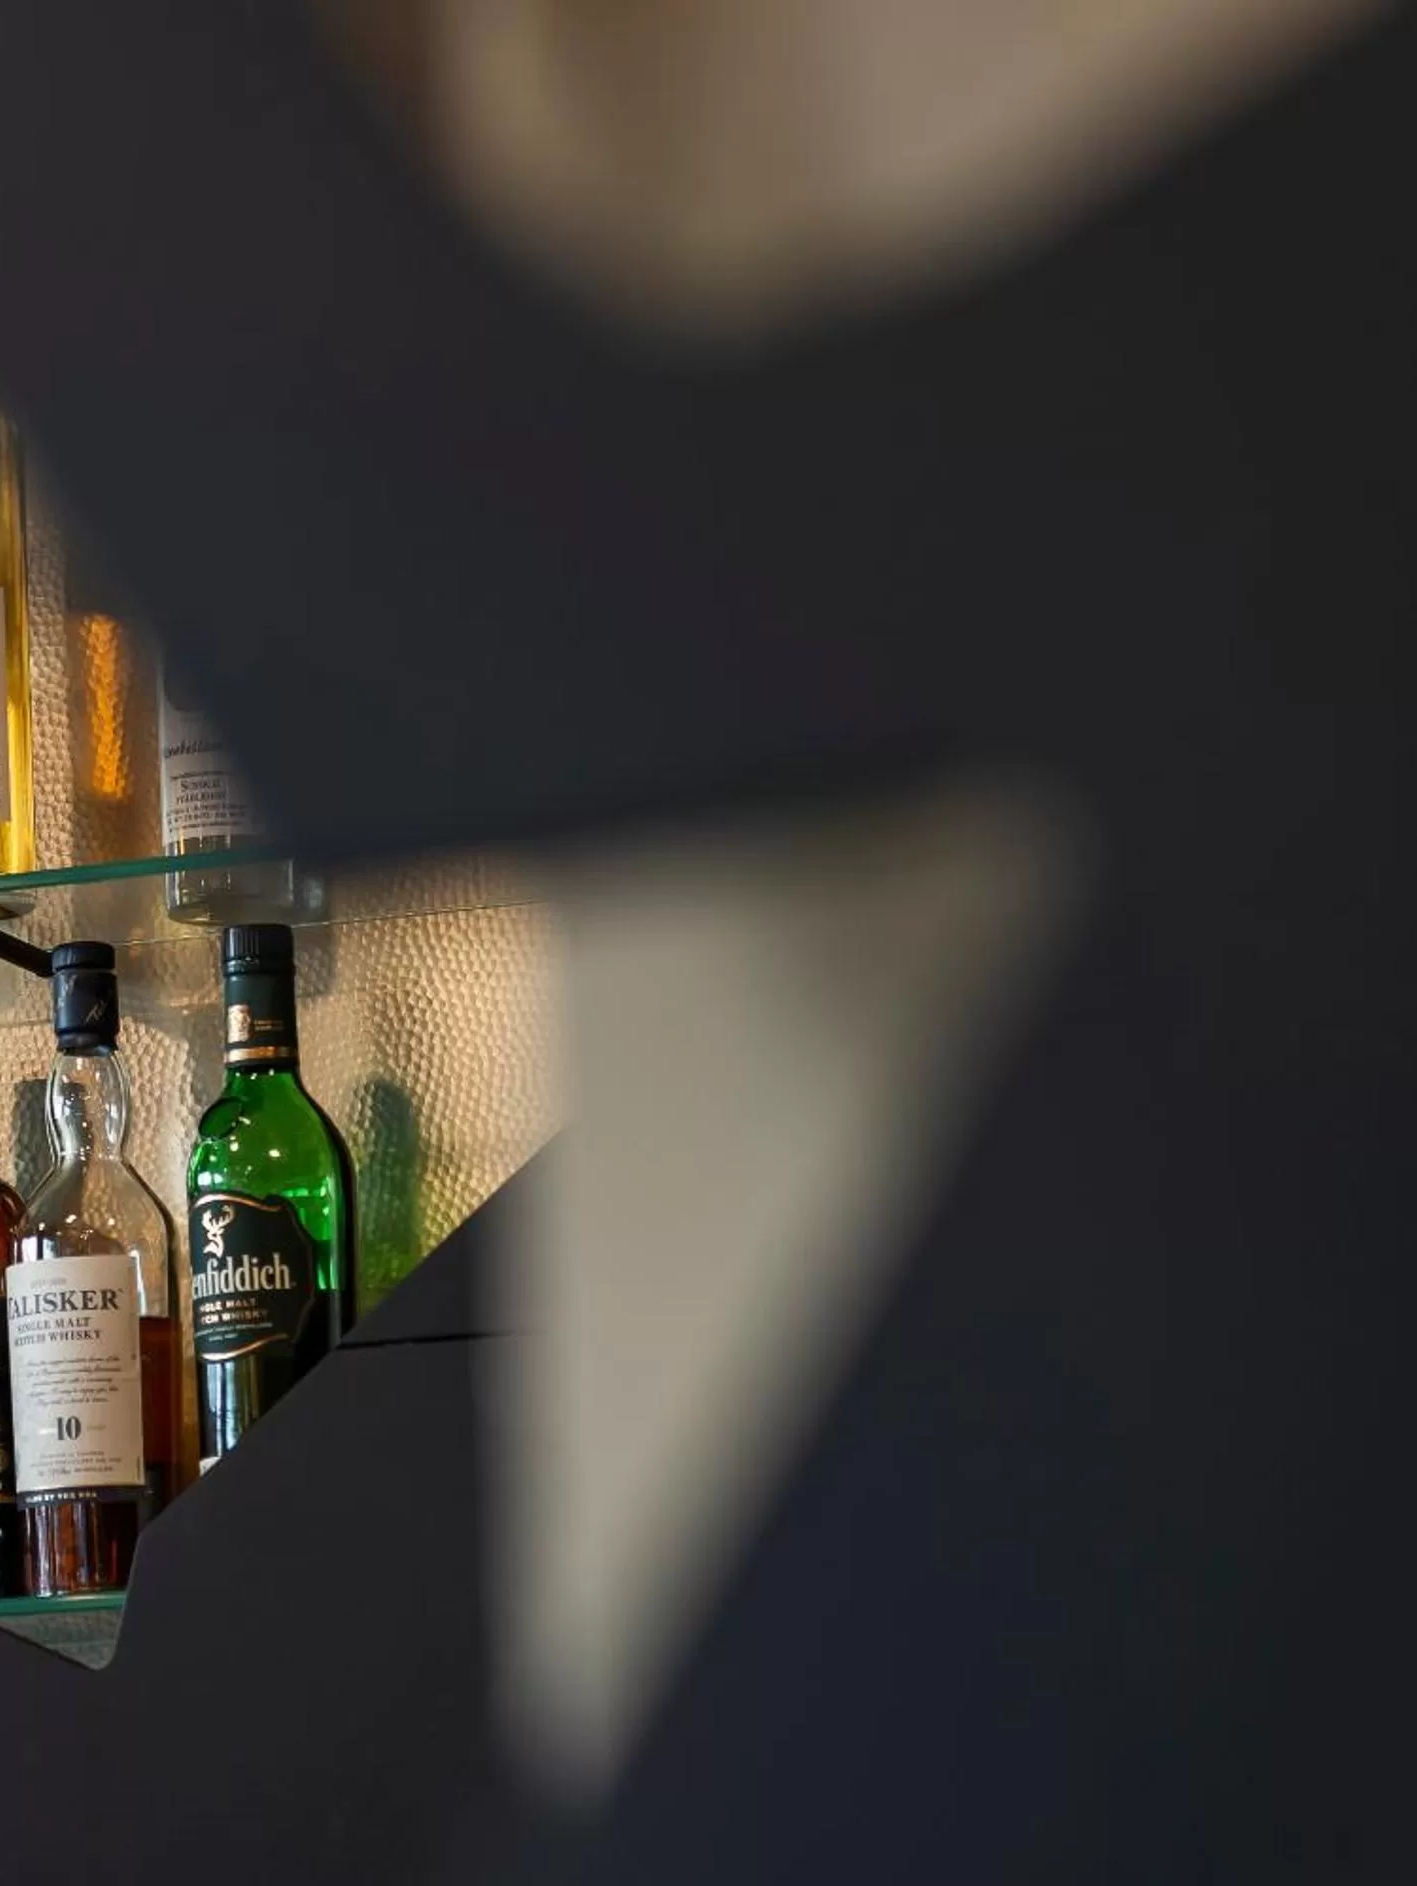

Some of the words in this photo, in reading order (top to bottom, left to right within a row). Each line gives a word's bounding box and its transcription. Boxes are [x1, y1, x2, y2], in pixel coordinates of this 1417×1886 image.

[55, 1317, 91, 1329] MALT
[49, 1329, 101, 1342] WHISKY
[56, 1415, 82, 1441] 10
